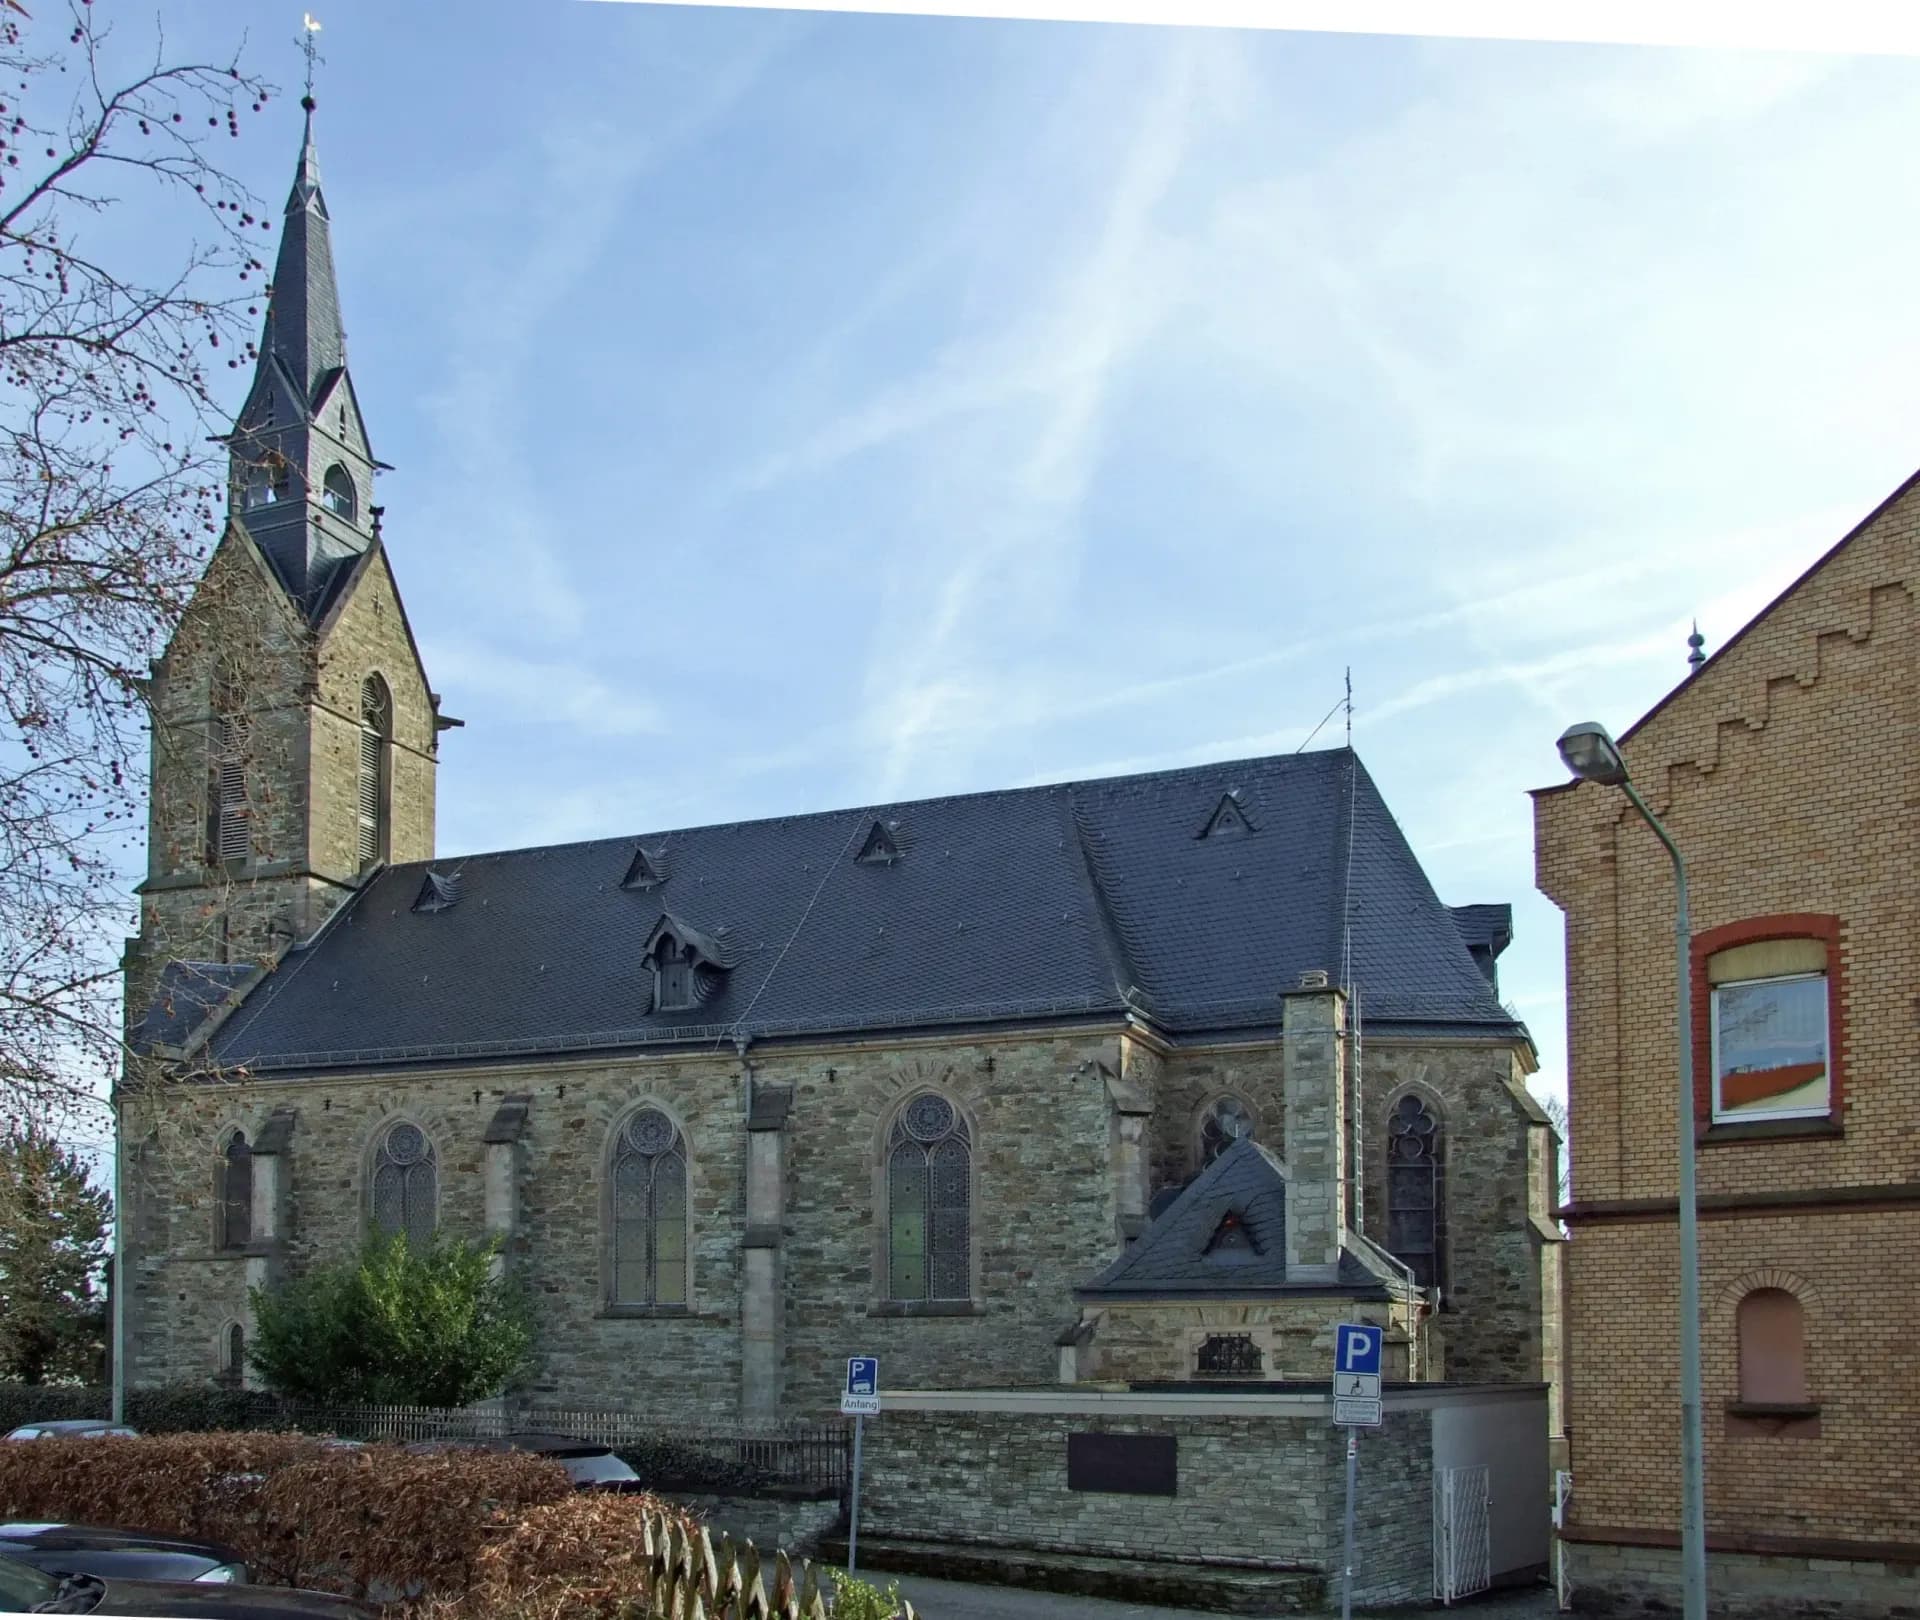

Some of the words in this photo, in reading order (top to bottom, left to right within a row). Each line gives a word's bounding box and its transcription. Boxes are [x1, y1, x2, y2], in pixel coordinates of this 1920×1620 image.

[1346, 1332, 1371, 1369] P
[852, 1361, 865, 1378] P
[844, 1399, 877, 1410] Anfang
